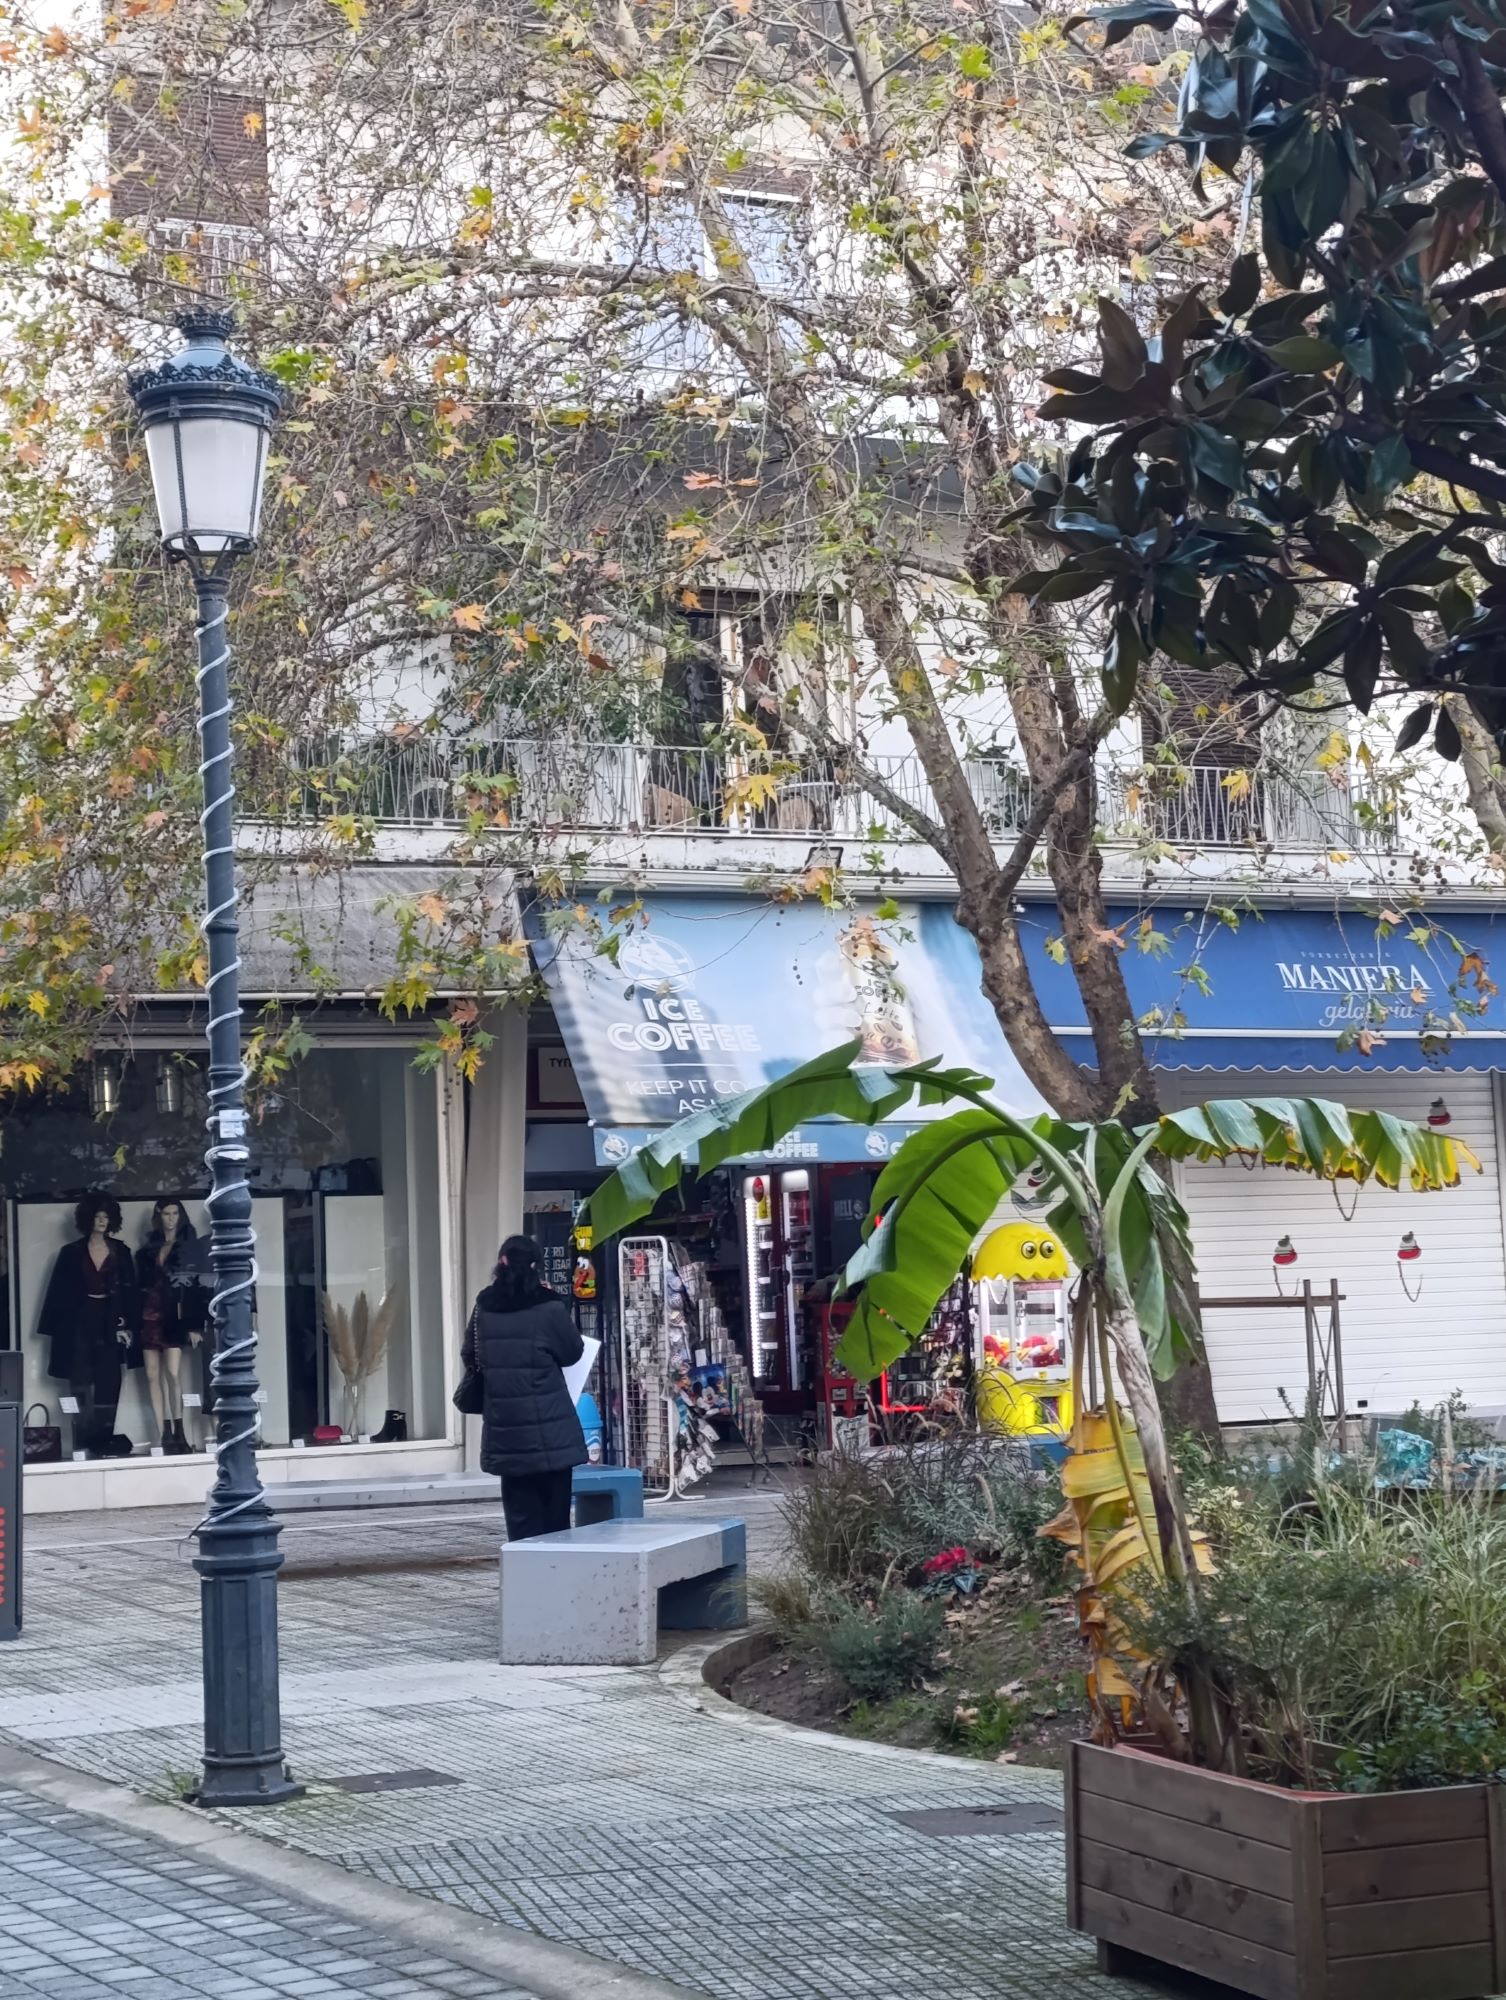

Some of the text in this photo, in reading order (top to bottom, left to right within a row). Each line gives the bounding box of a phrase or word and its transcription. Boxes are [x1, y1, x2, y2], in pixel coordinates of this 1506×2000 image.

[1275, 962, 1432, 991] MANIERA
[642, 998, 704, 1021] ICE
[1318, 996, 1418, 1028] gelaria
[607, 1022, 762, 1051] COFFEE
[625, 1080, 683, 1095] KEEP
[688, 1080, 707, 1095] IT
[678, 1099, 705, 1114] AS
